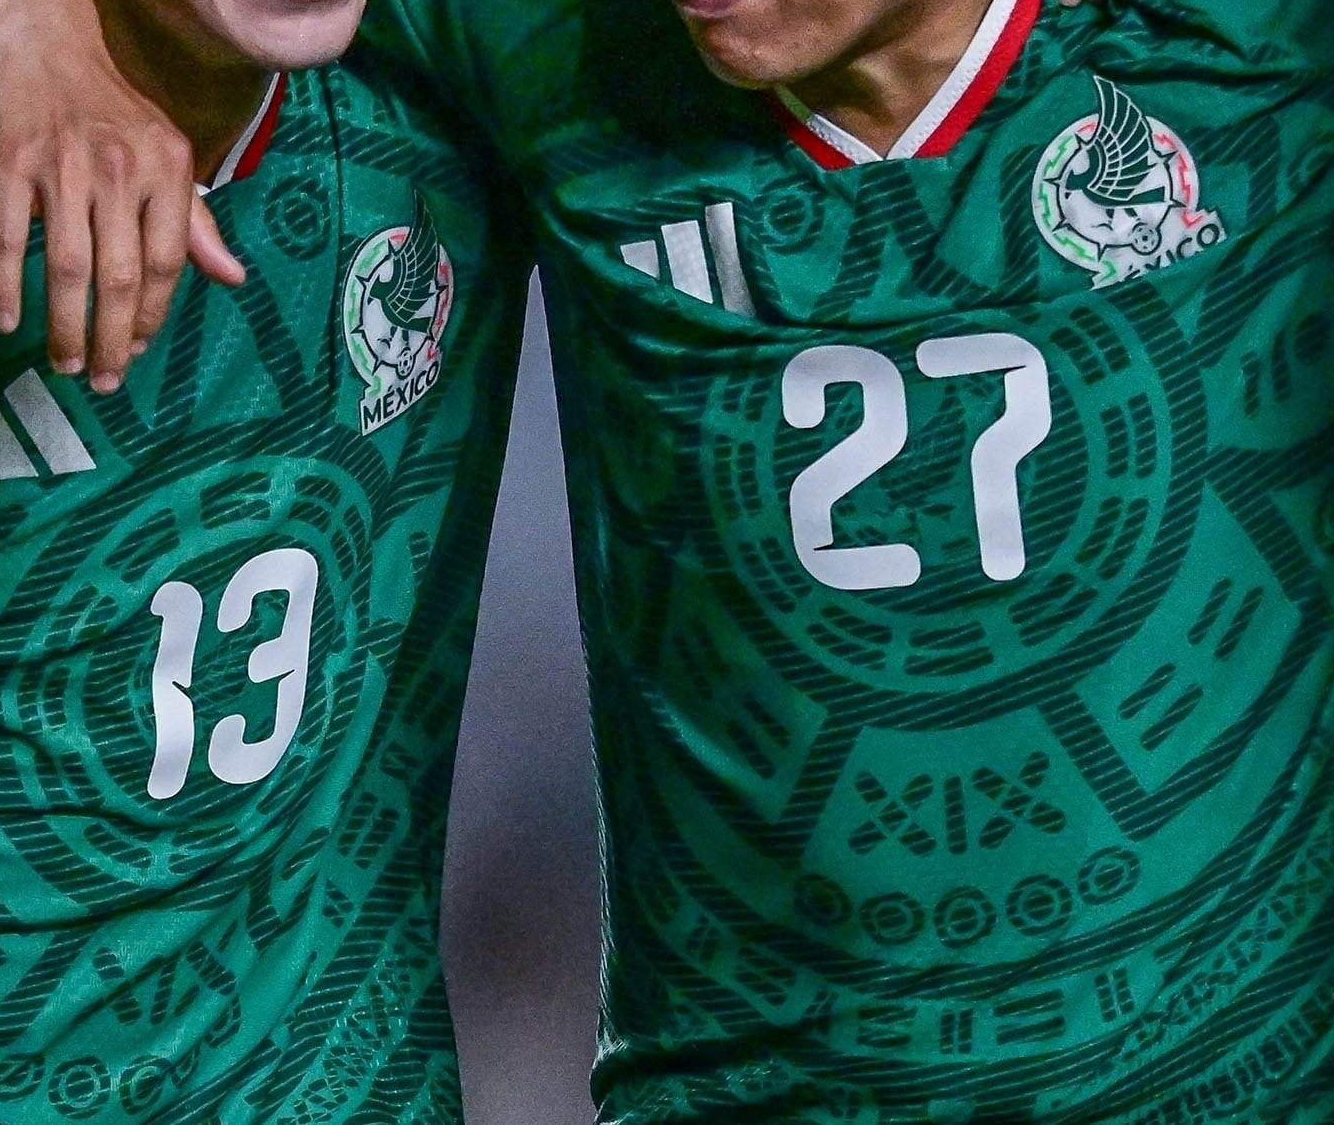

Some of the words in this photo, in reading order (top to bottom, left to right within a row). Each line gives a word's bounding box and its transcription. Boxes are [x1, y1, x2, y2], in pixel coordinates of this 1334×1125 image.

[362, 360, 440, 430] MÉXICO
[781, 331, 1052, 590] 27
[147, 547, 319, 800] 13
